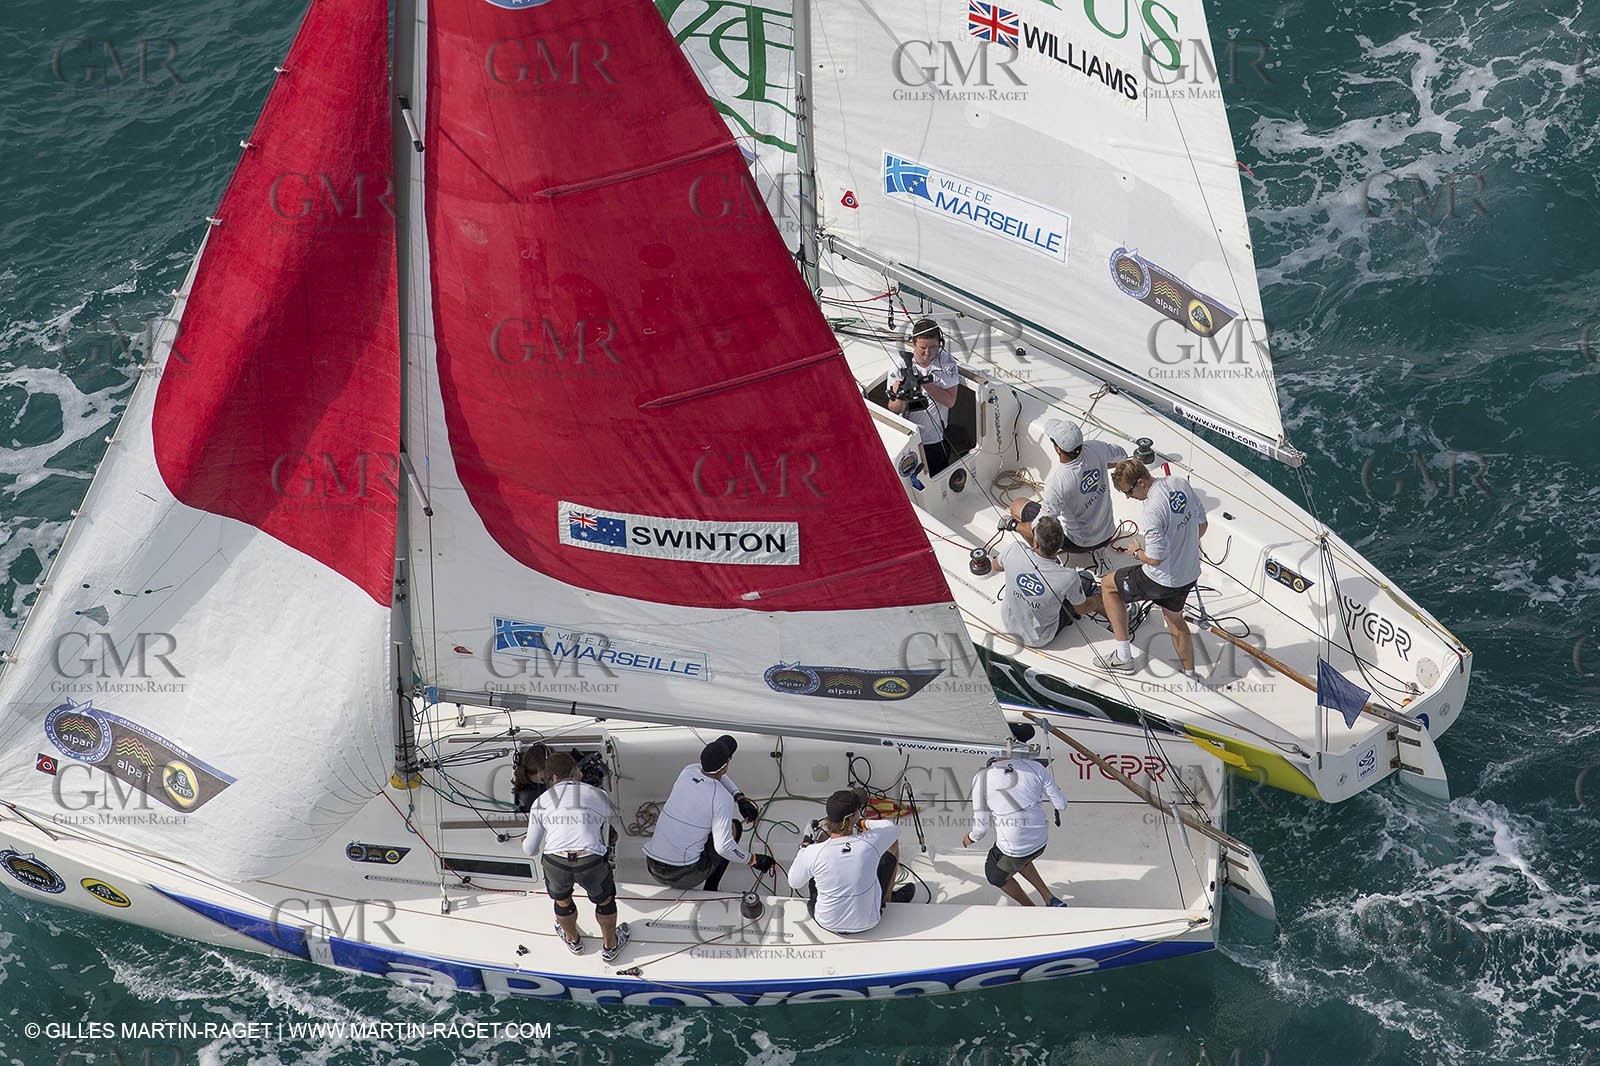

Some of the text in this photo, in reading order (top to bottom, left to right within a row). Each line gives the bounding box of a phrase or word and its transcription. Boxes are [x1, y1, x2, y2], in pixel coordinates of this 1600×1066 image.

[1023, 22, 1138, 100] WILLIAMS
[940, 178, 992, 205] VILLE DE
[935, 191, 1062, 253] MARSEILLE
[1154, 297, 1180, 316] alpari
[1185, 411, 1258, 449] www.wmrt.com
[632, 526, 786, 553] SWINTON
[557, 632, 617, 649] VILLE DE
[1344, 595, 1412, 661] YCPR
[553, 642, 702, 676] MARSEILLE
[827, 687, 862, 696] alpari
[118, 718, 145, 734] OFFICIAL
[62, 733, 94, 749] alpari
[896, 742, 988, 756] www.wmrt.com
[117, 758, 151, 783] alpari
